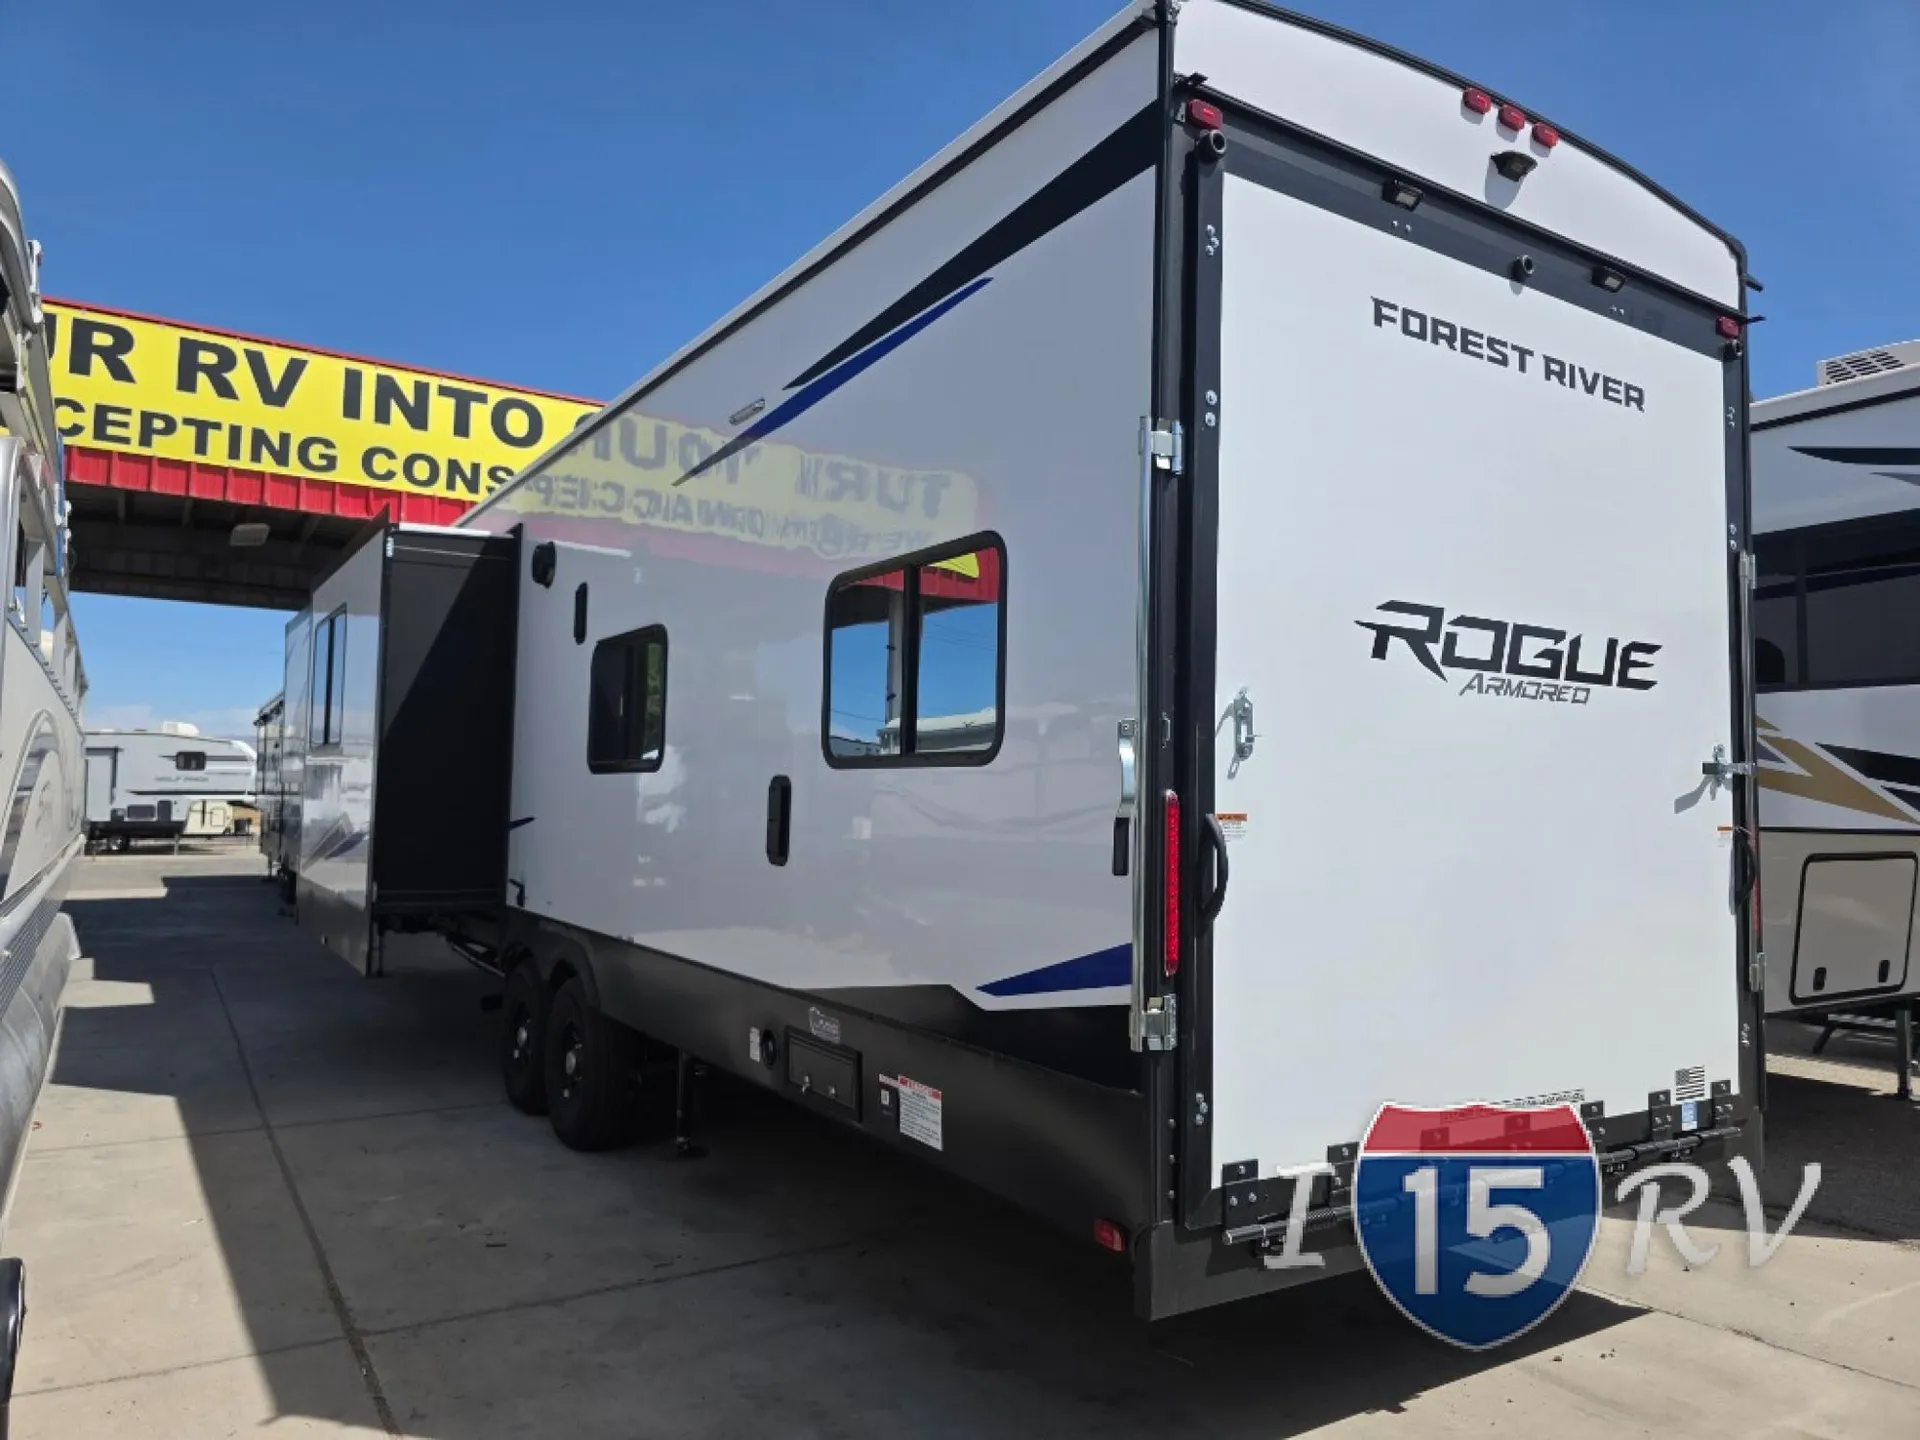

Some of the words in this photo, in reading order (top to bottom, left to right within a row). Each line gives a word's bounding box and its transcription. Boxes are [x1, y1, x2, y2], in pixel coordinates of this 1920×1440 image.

[176, 336, 309, 408] RV
[342, 366, 544, 449] INTO
[1371, 296, 1534, 374] FOREST
[1542, 354, 1645, 413] RIVER
[1353, 599, 1663, 691] ROGUE
[1458, 672, 1590, 705] ARMORED
